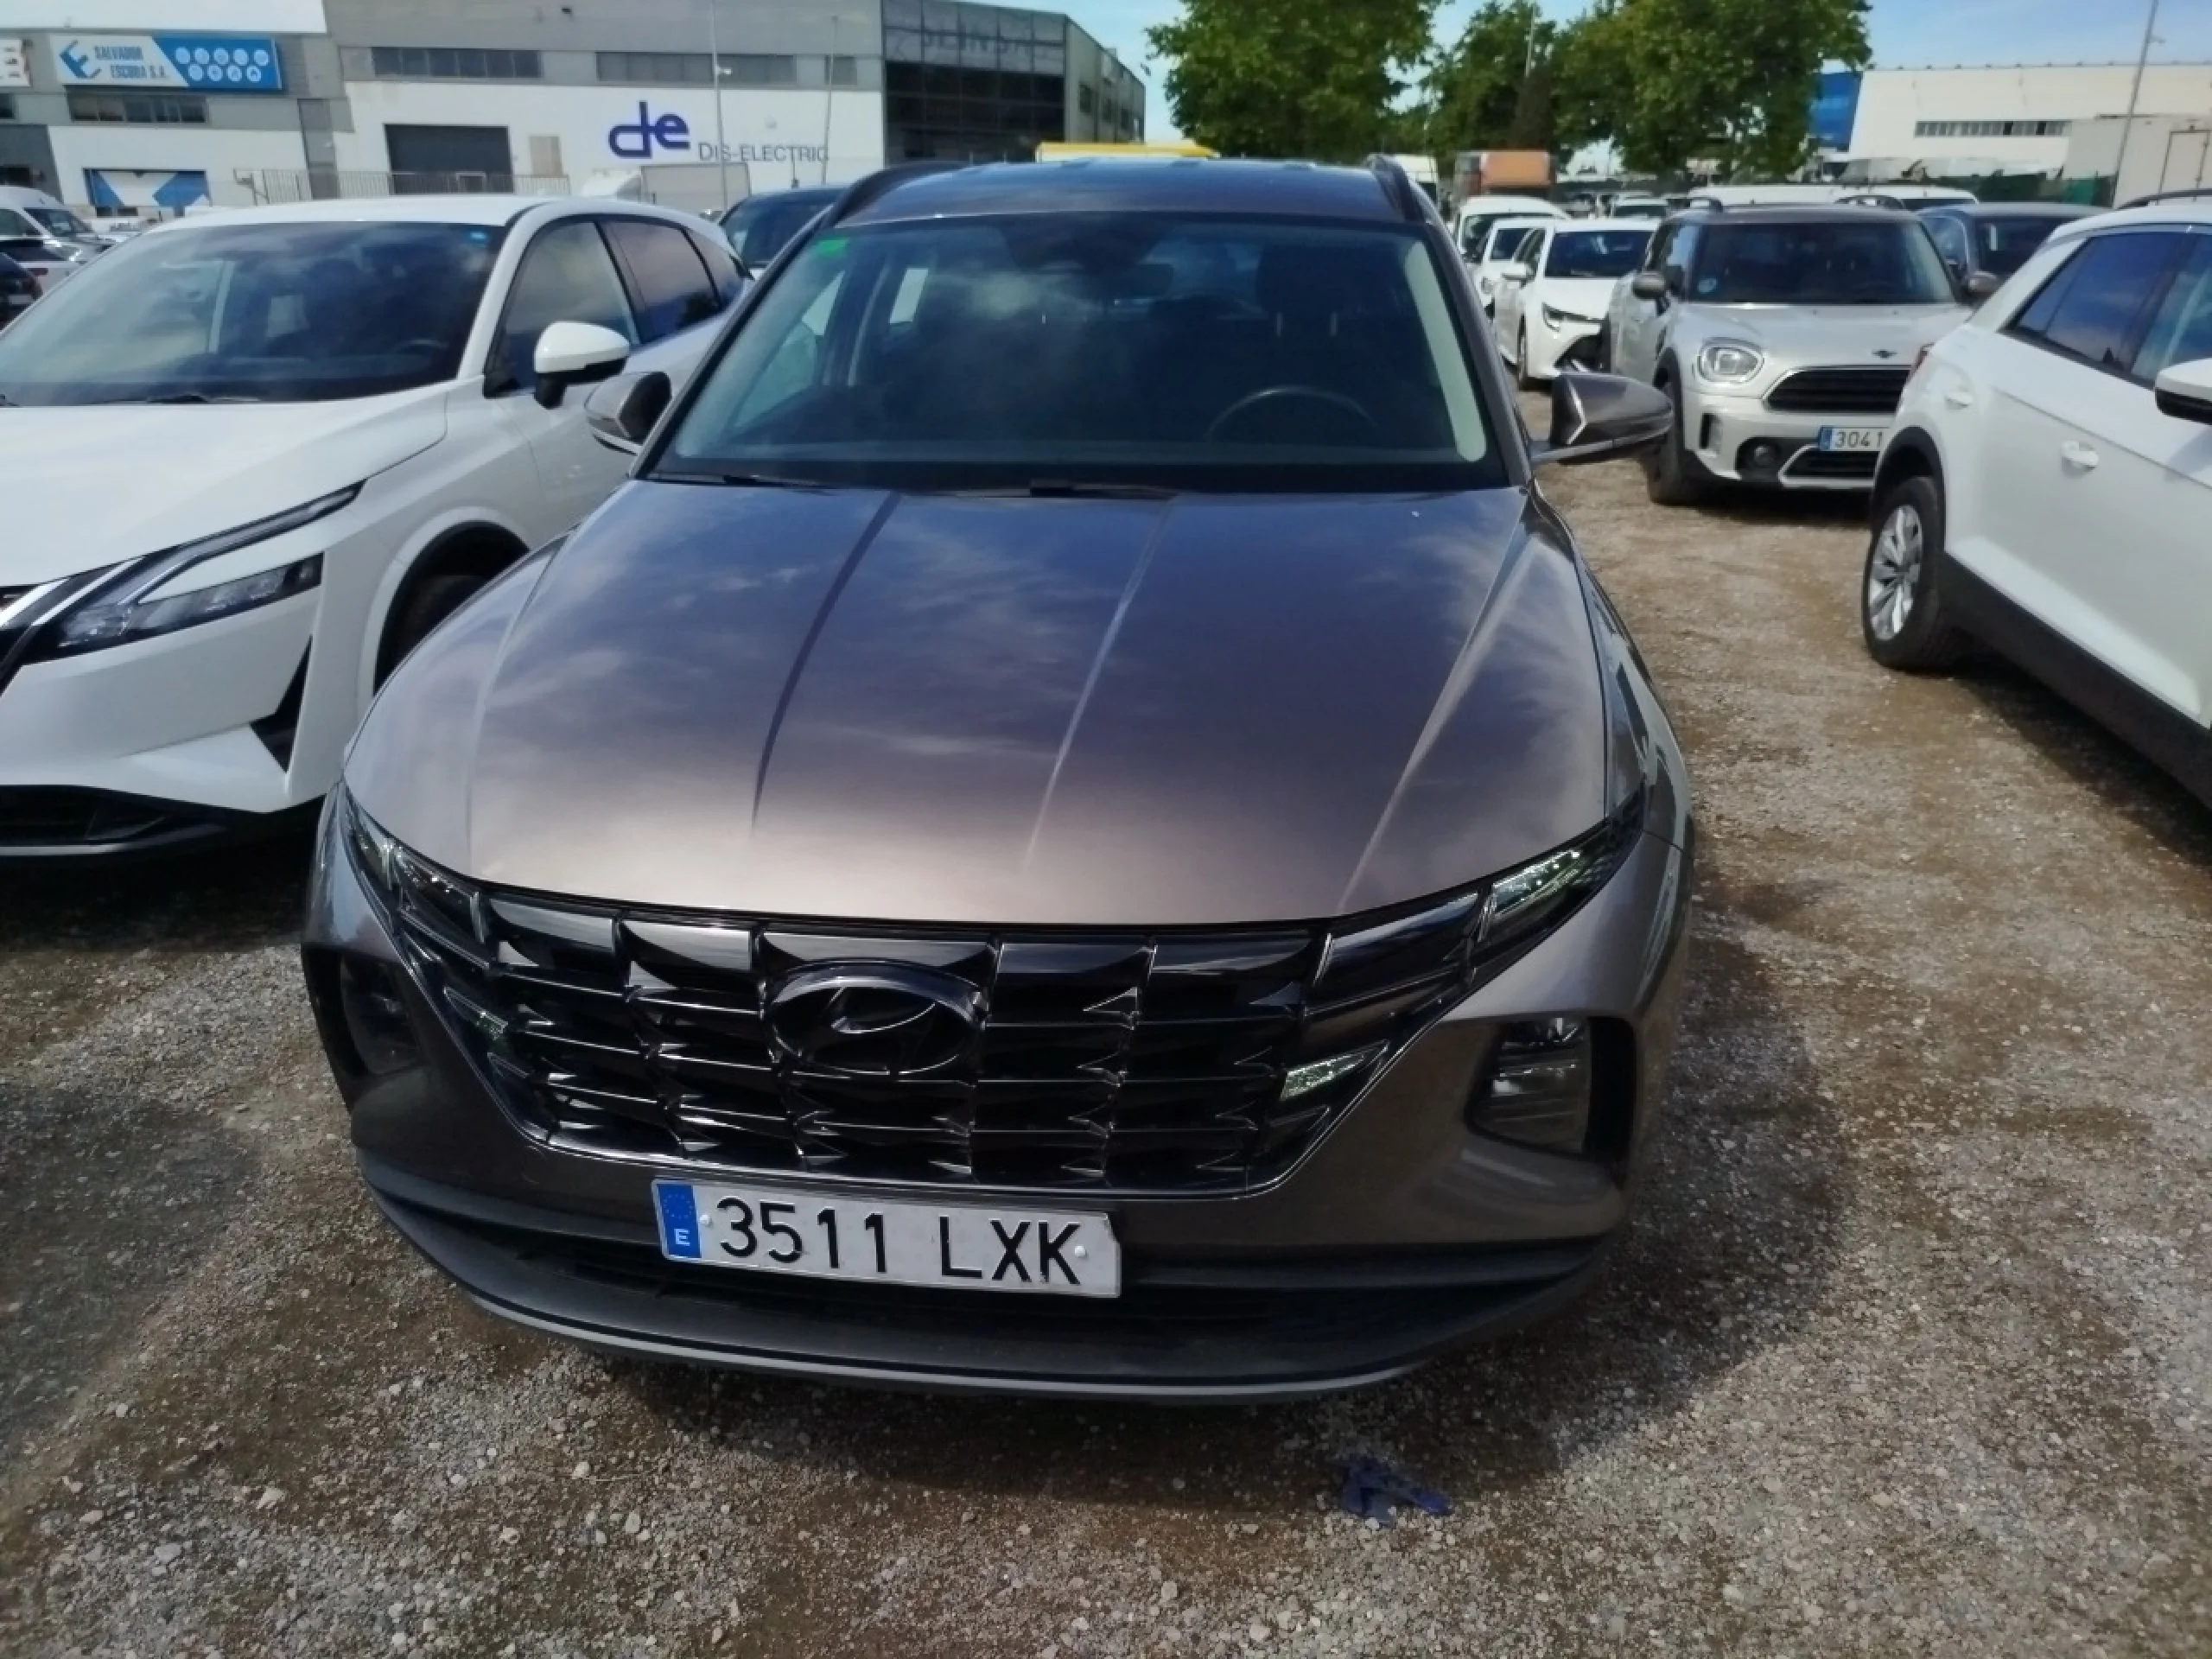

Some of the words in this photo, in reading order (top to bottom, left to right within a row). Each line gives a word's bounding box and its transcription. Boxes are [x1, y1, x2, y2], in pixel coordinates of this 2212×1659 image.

[93, 46, 143, 60] SALVADOR
[1834, 431, 1883, 448] 3041
[675, 1228, 690, 1246] E
[716, 1196, 887, 1274] 3511
[939, 1215, 1082, 1285] LXK
